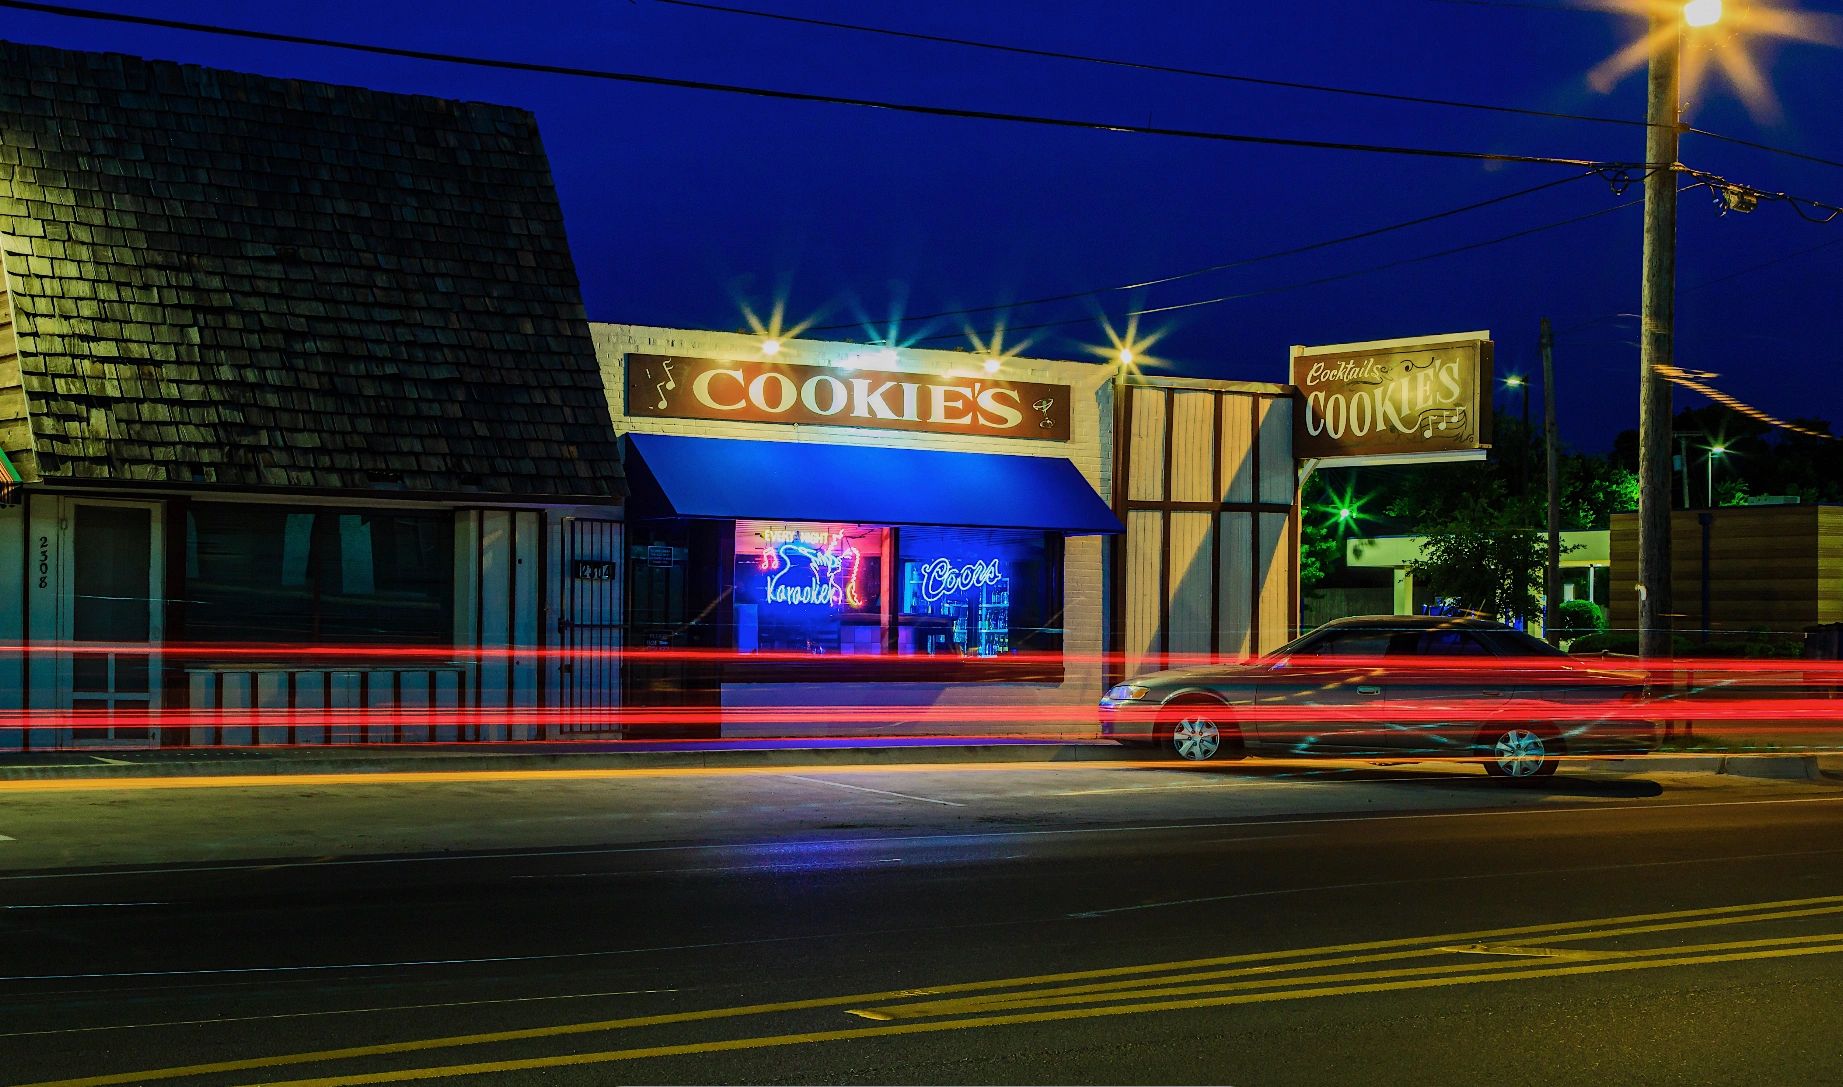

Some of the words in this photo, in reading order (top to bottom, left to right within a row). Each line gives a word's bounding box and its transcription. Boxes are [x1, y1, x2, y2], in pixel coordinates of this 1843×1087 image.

[1306, 357, 1381, 386] Cocktails
[693, 368, 1023, 429] COOKIE'S
[1305, 358, 1462, 440] COOKIE'S
[39, 536, 49, 589] 2308
[921, 558, 1002, 602] Coors
